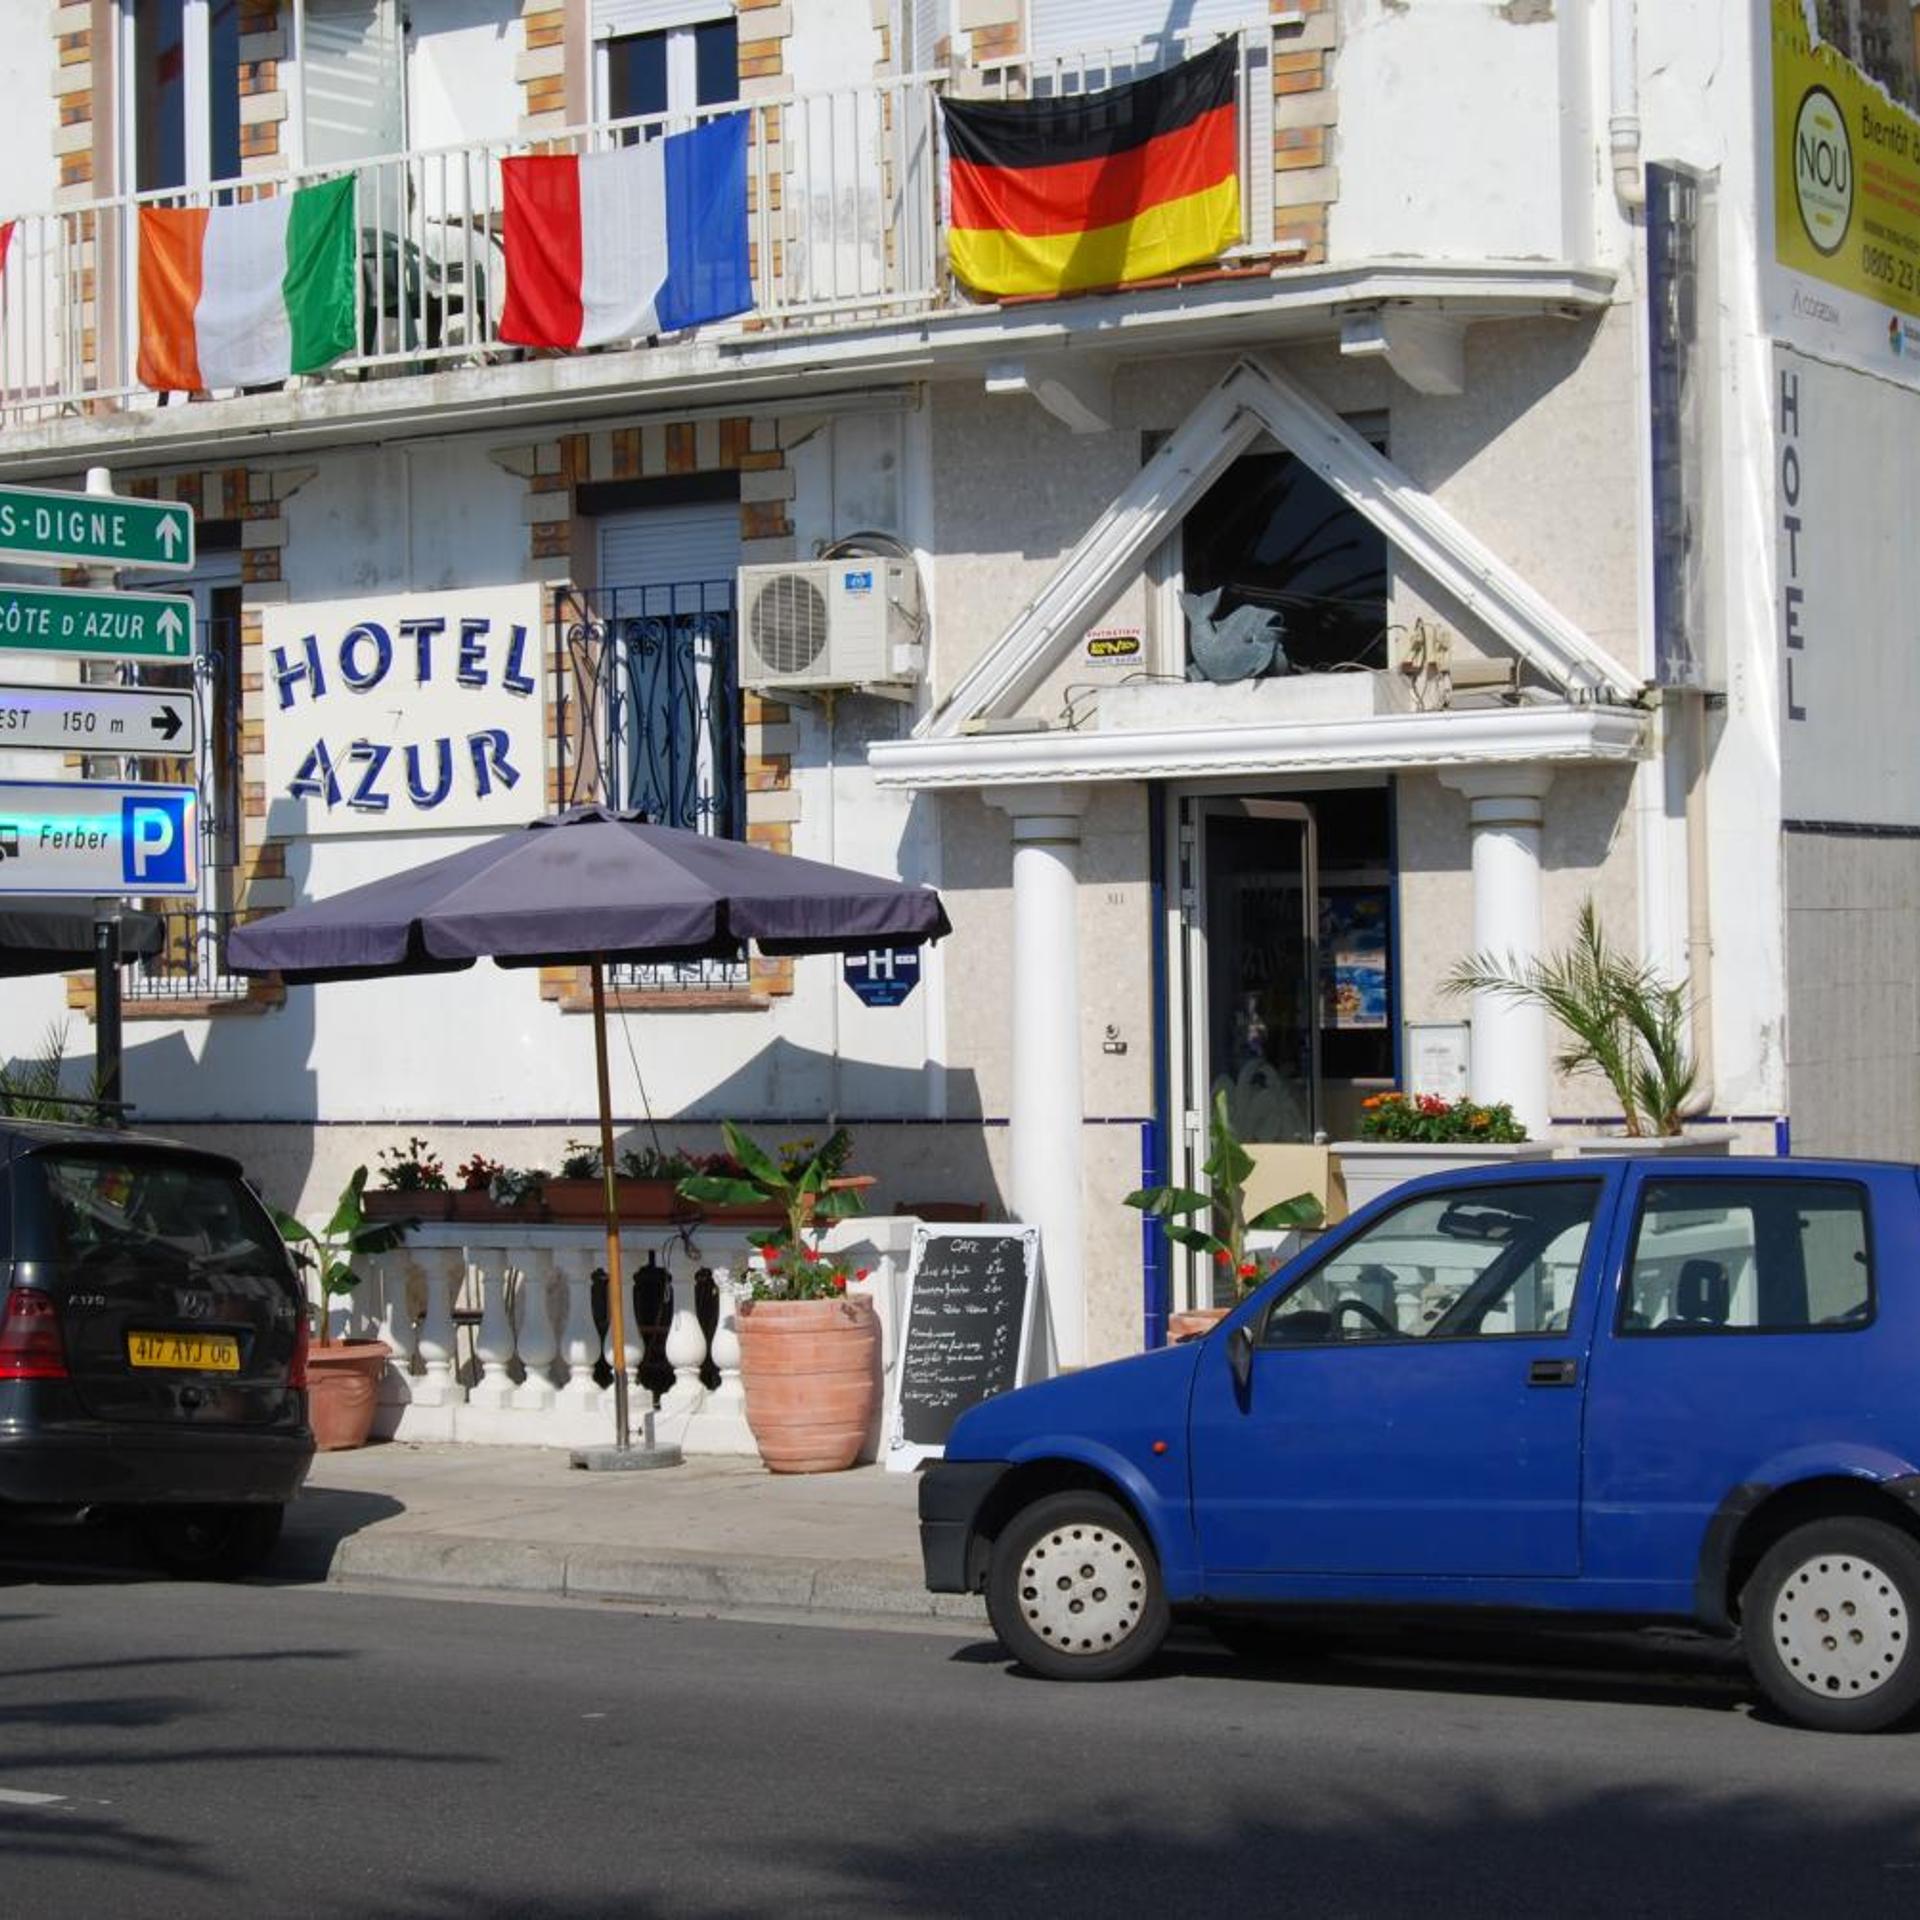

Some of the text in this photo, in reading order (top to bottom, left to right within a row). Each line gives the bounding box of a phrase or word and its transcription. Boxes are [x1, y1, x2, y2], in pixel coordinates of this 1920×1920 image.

[1800, 131, 1847, 193] NOU
[0, 504, 126, 547] S-DIGNE
[1781, 370, 1807, 721] HOTEL
[270, 617, 536, 710] HOTEL
[62, 711, 97, 732] 150
[110, 718, 125, 733] m
[285, 729, 521, 815] AZUR
[39, 806, 174, 878] Ferber P
[135, 1337, 165, 1361] 417
[210, 1343, 231, 1365] 06
